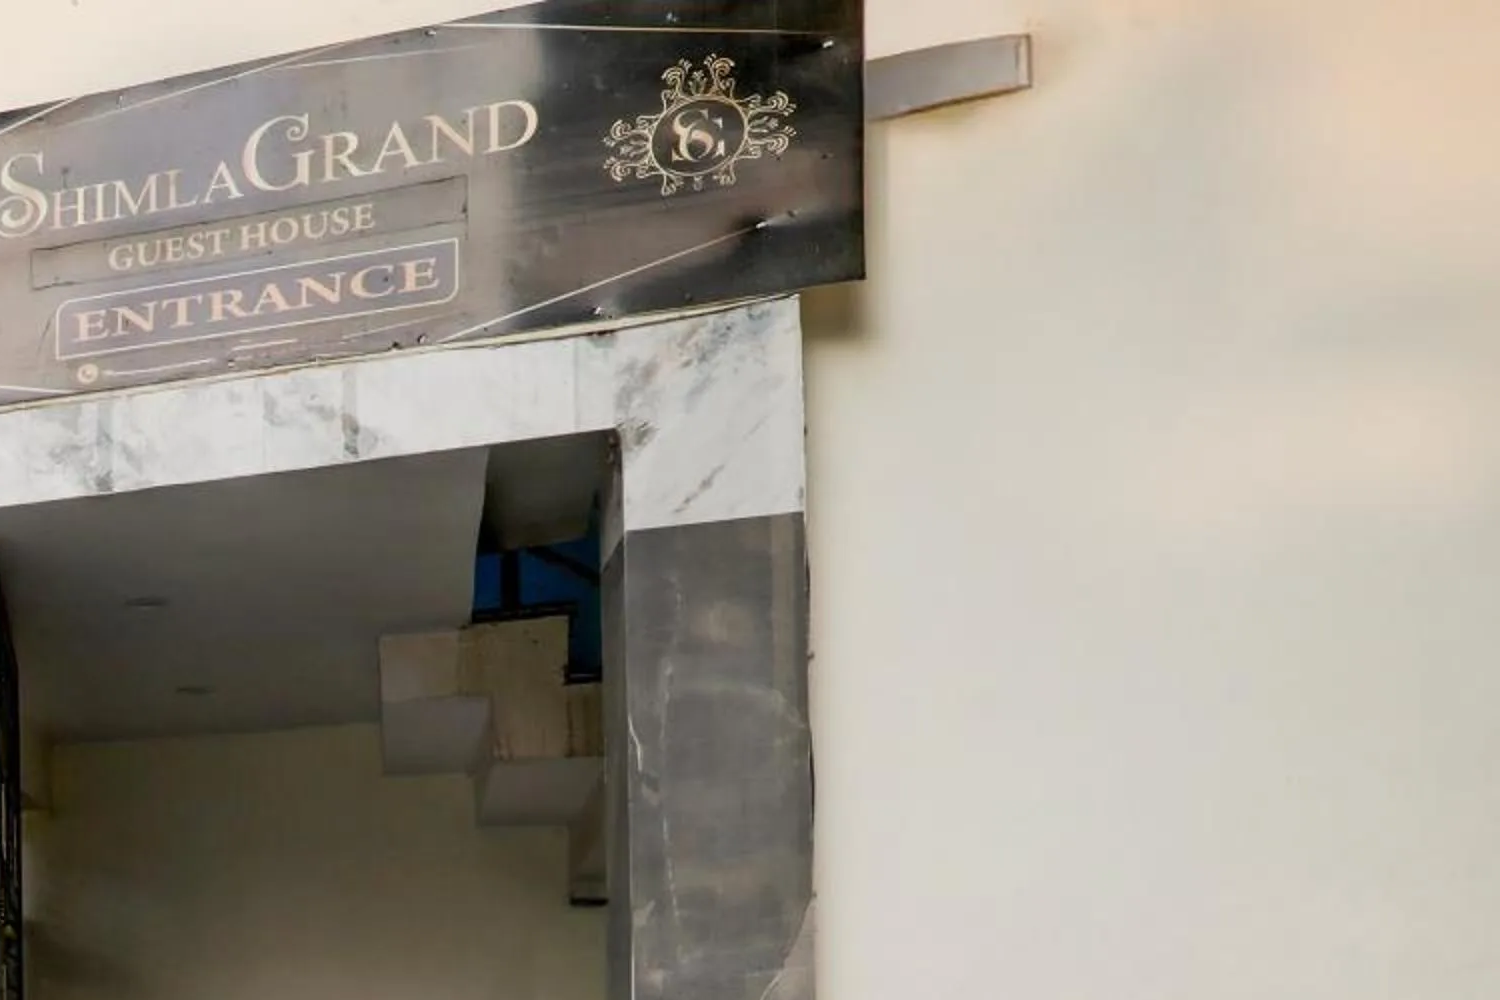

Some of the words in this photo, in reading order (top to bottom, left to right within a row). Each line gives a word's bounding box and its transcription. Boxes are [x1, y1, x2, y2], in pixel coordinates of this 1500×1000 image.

[107, 228, 230, 271] GUEST
[239, 203, 376, 251] HOUSE
[73, 256, 439, 343] ENTRANCE
